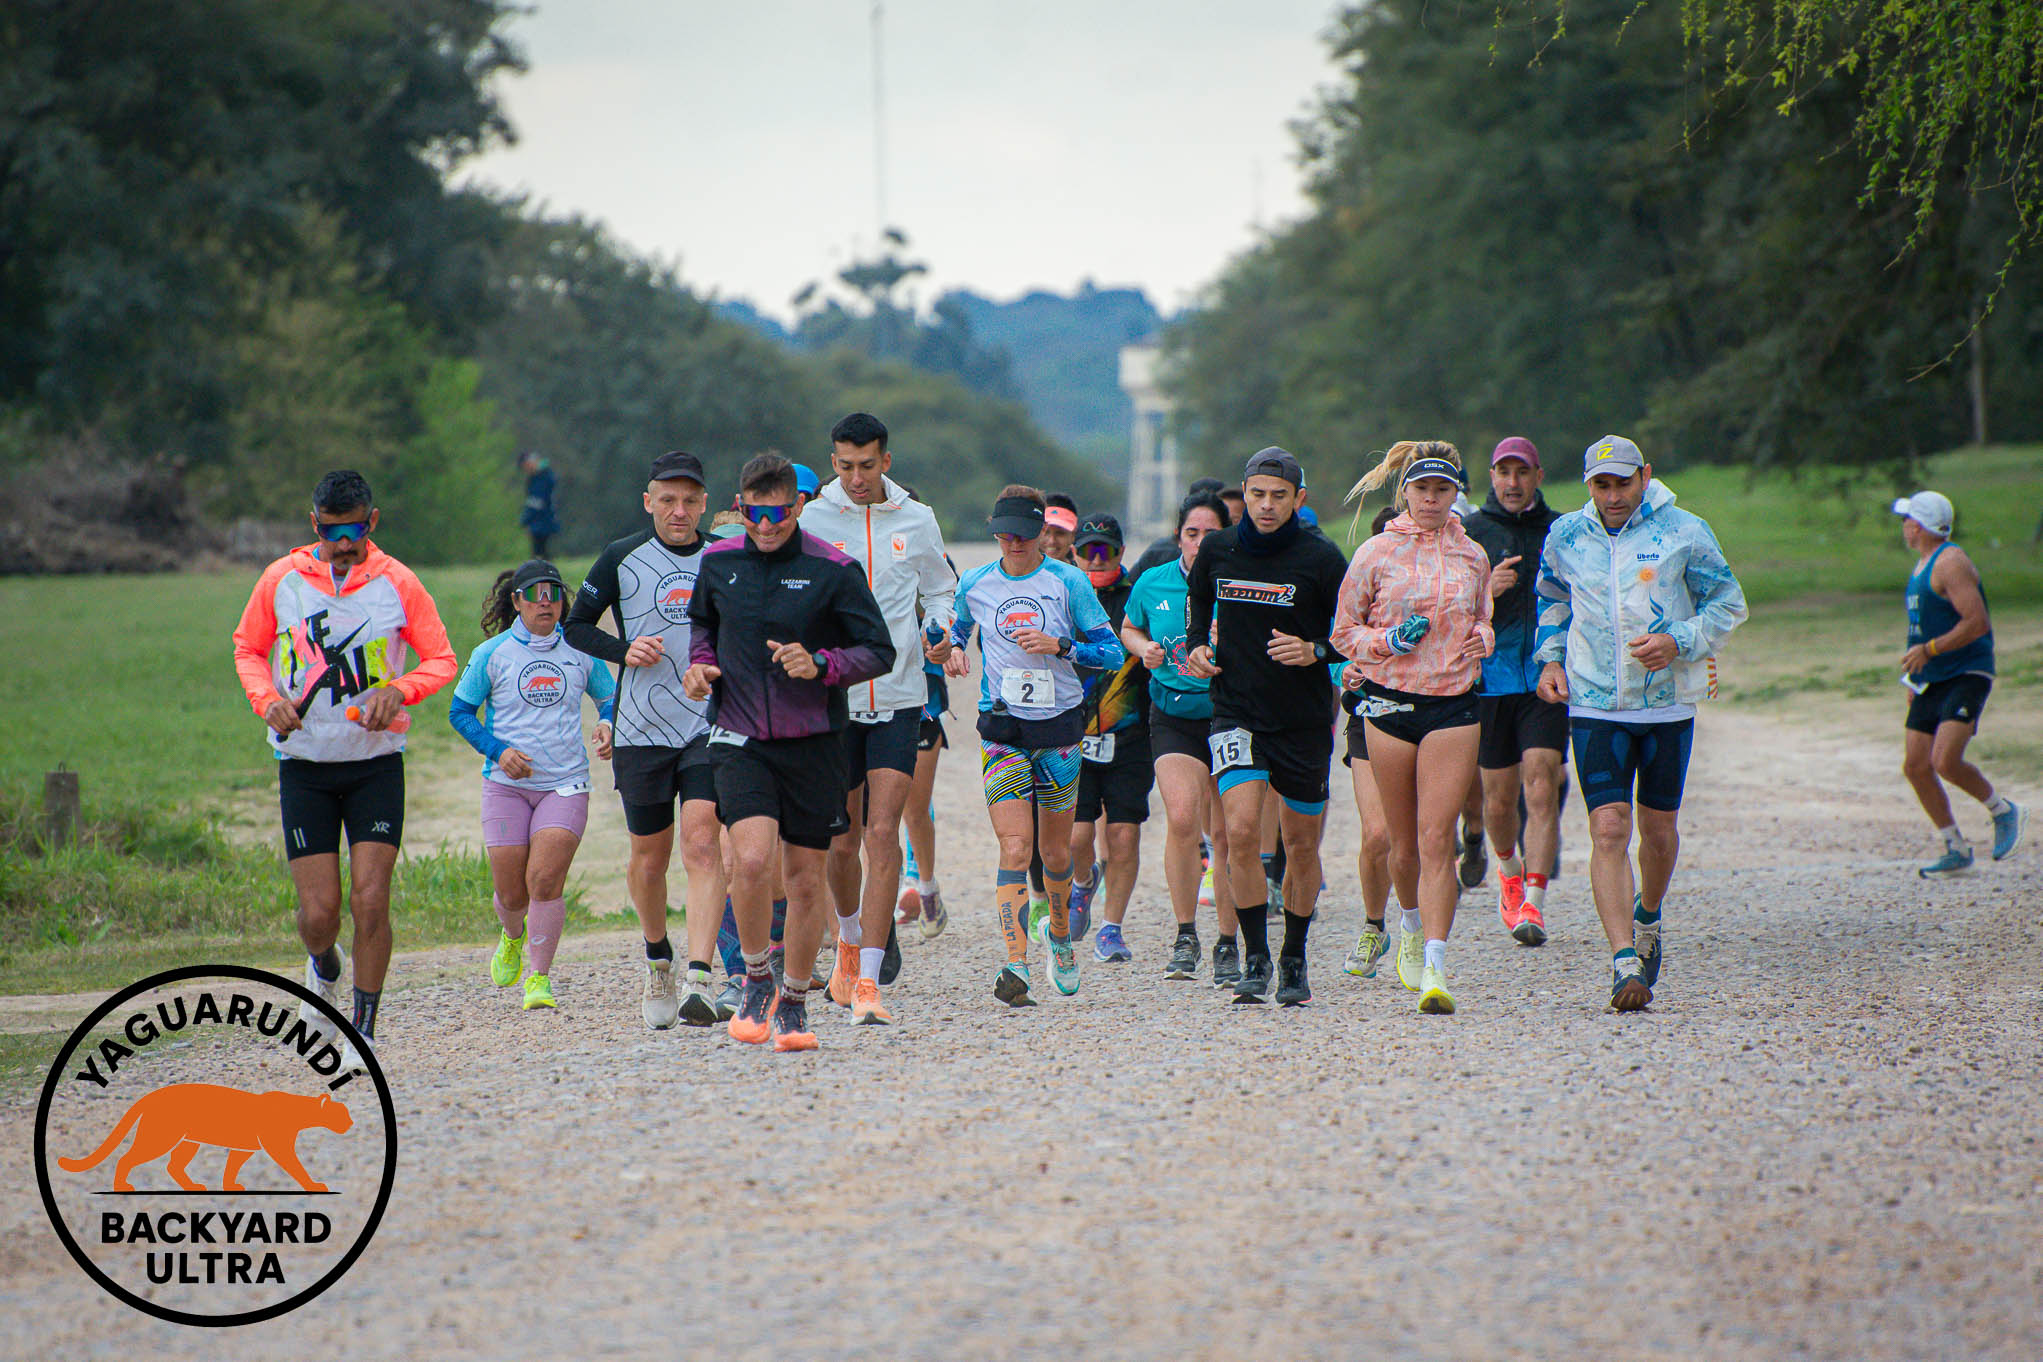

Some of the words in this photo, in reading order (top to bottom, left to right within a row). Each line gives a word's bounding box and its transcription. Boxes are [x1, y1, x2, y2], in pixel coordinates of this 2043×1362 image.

[1021, 682, 1034, 704] 2
[1082, 740, 1102, 758] 21
[1216, 741, 1240, 766] 15
[371, 820, 390, 834] XR
